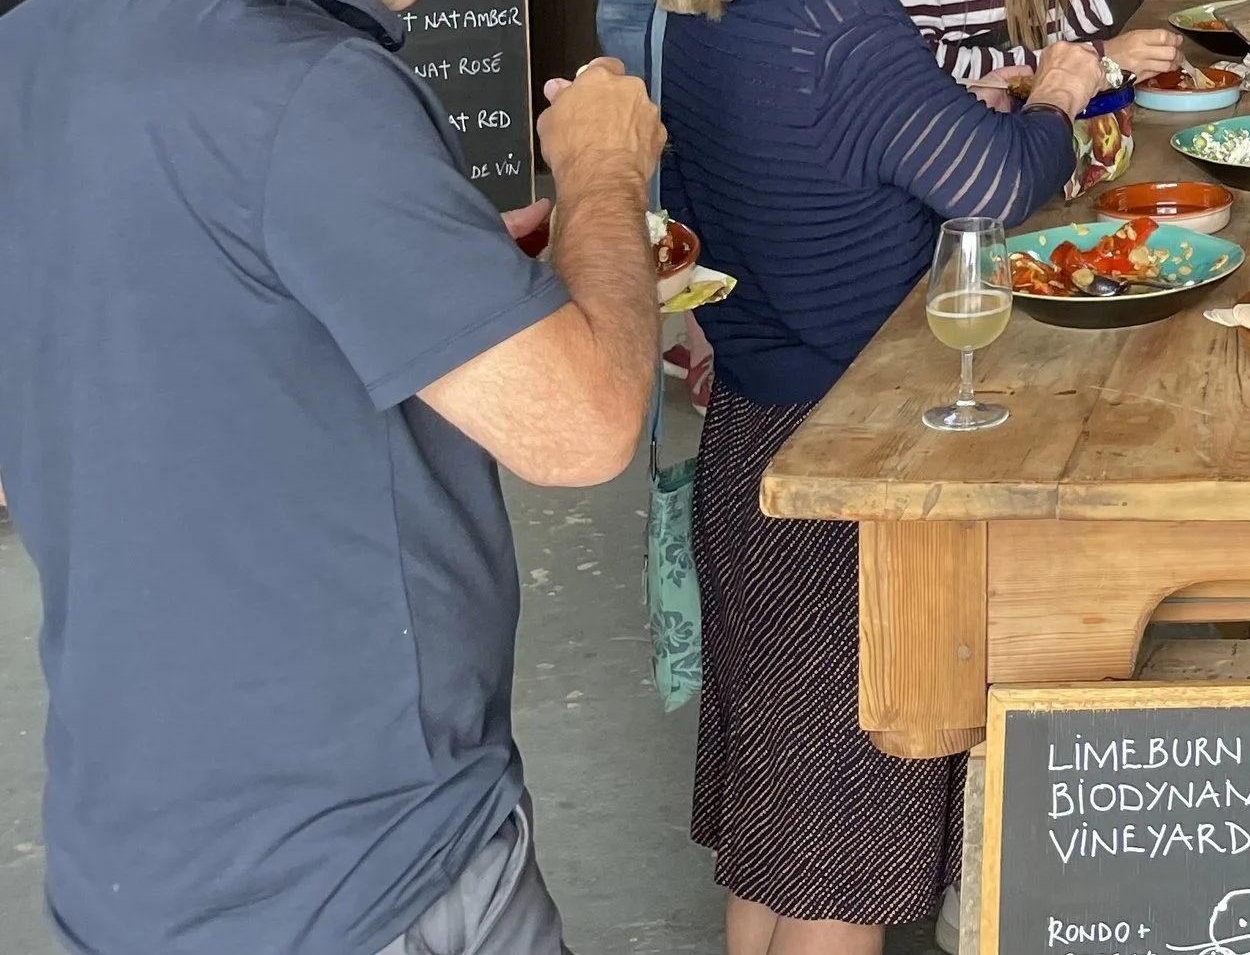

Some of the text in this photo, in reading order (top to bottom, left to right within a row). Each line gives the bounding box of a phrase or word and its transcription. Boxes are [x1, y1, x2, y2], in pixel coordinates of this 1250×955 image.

[464, 7, 523, 28] AMBER
[478, 110, 511, 128] RED
[471, 164, 490, 179] DE
[1048, 916, 1131, 948] RONDO
